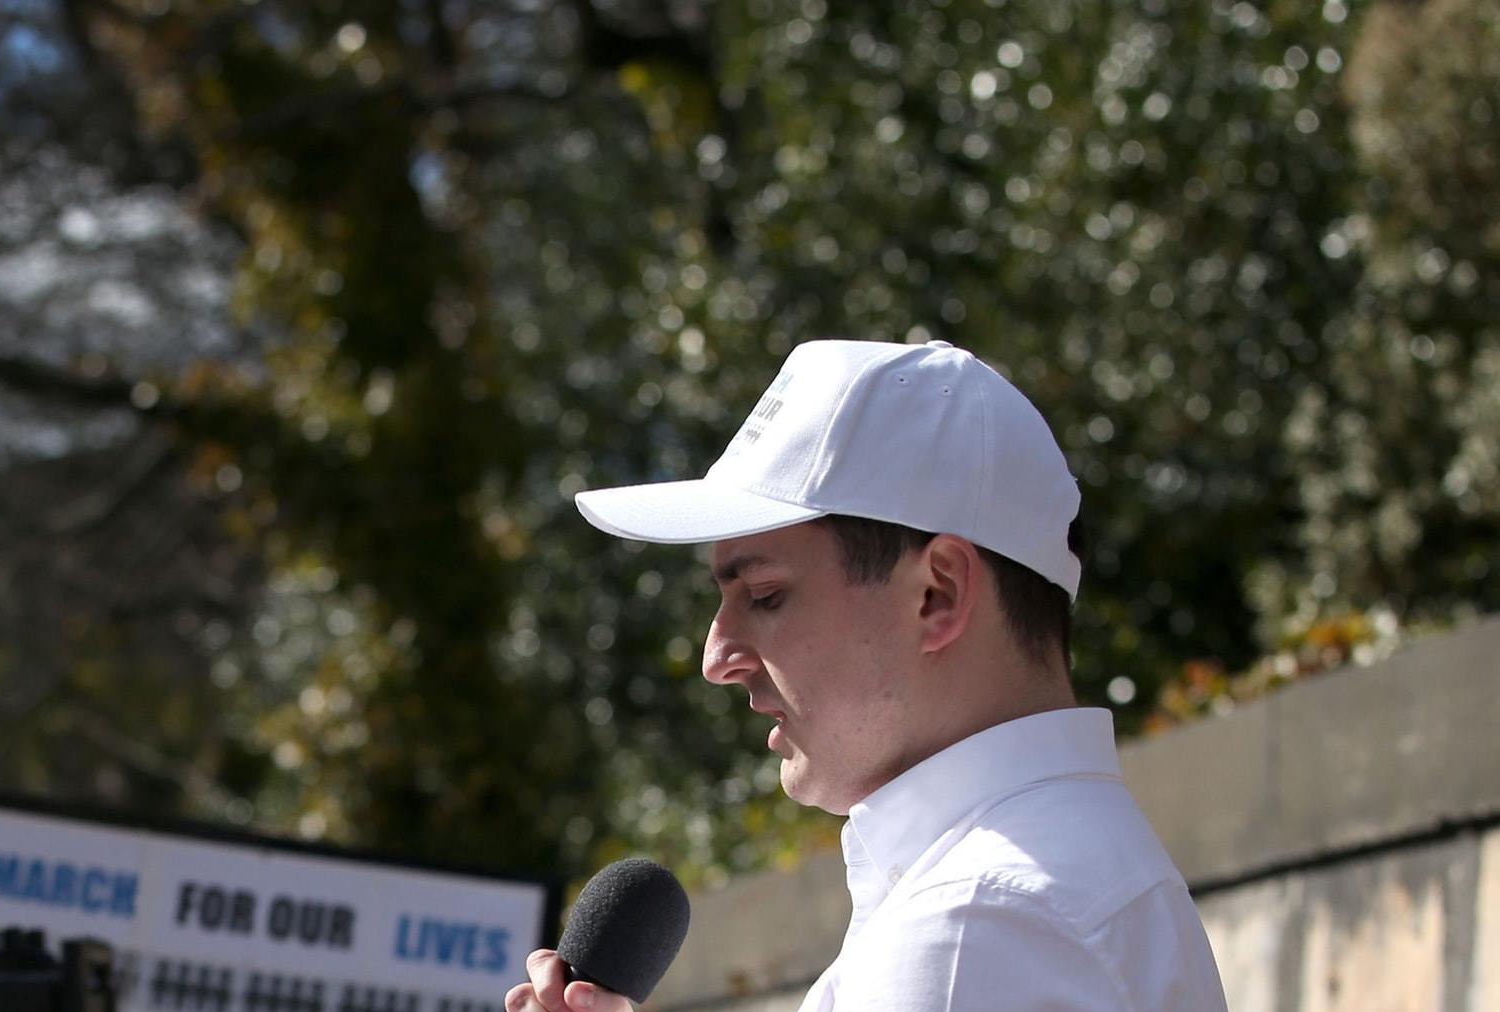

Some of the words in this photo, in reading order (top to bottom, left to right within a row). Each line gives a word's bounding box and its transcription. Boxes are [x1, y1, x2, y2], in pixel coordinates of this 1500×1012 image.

[752, 395, 784, 422] UR
[176, 878, 257, 936] FOR
[268, 892, 355, 949] OUR
[394, 911, 512, 975] LIVES
